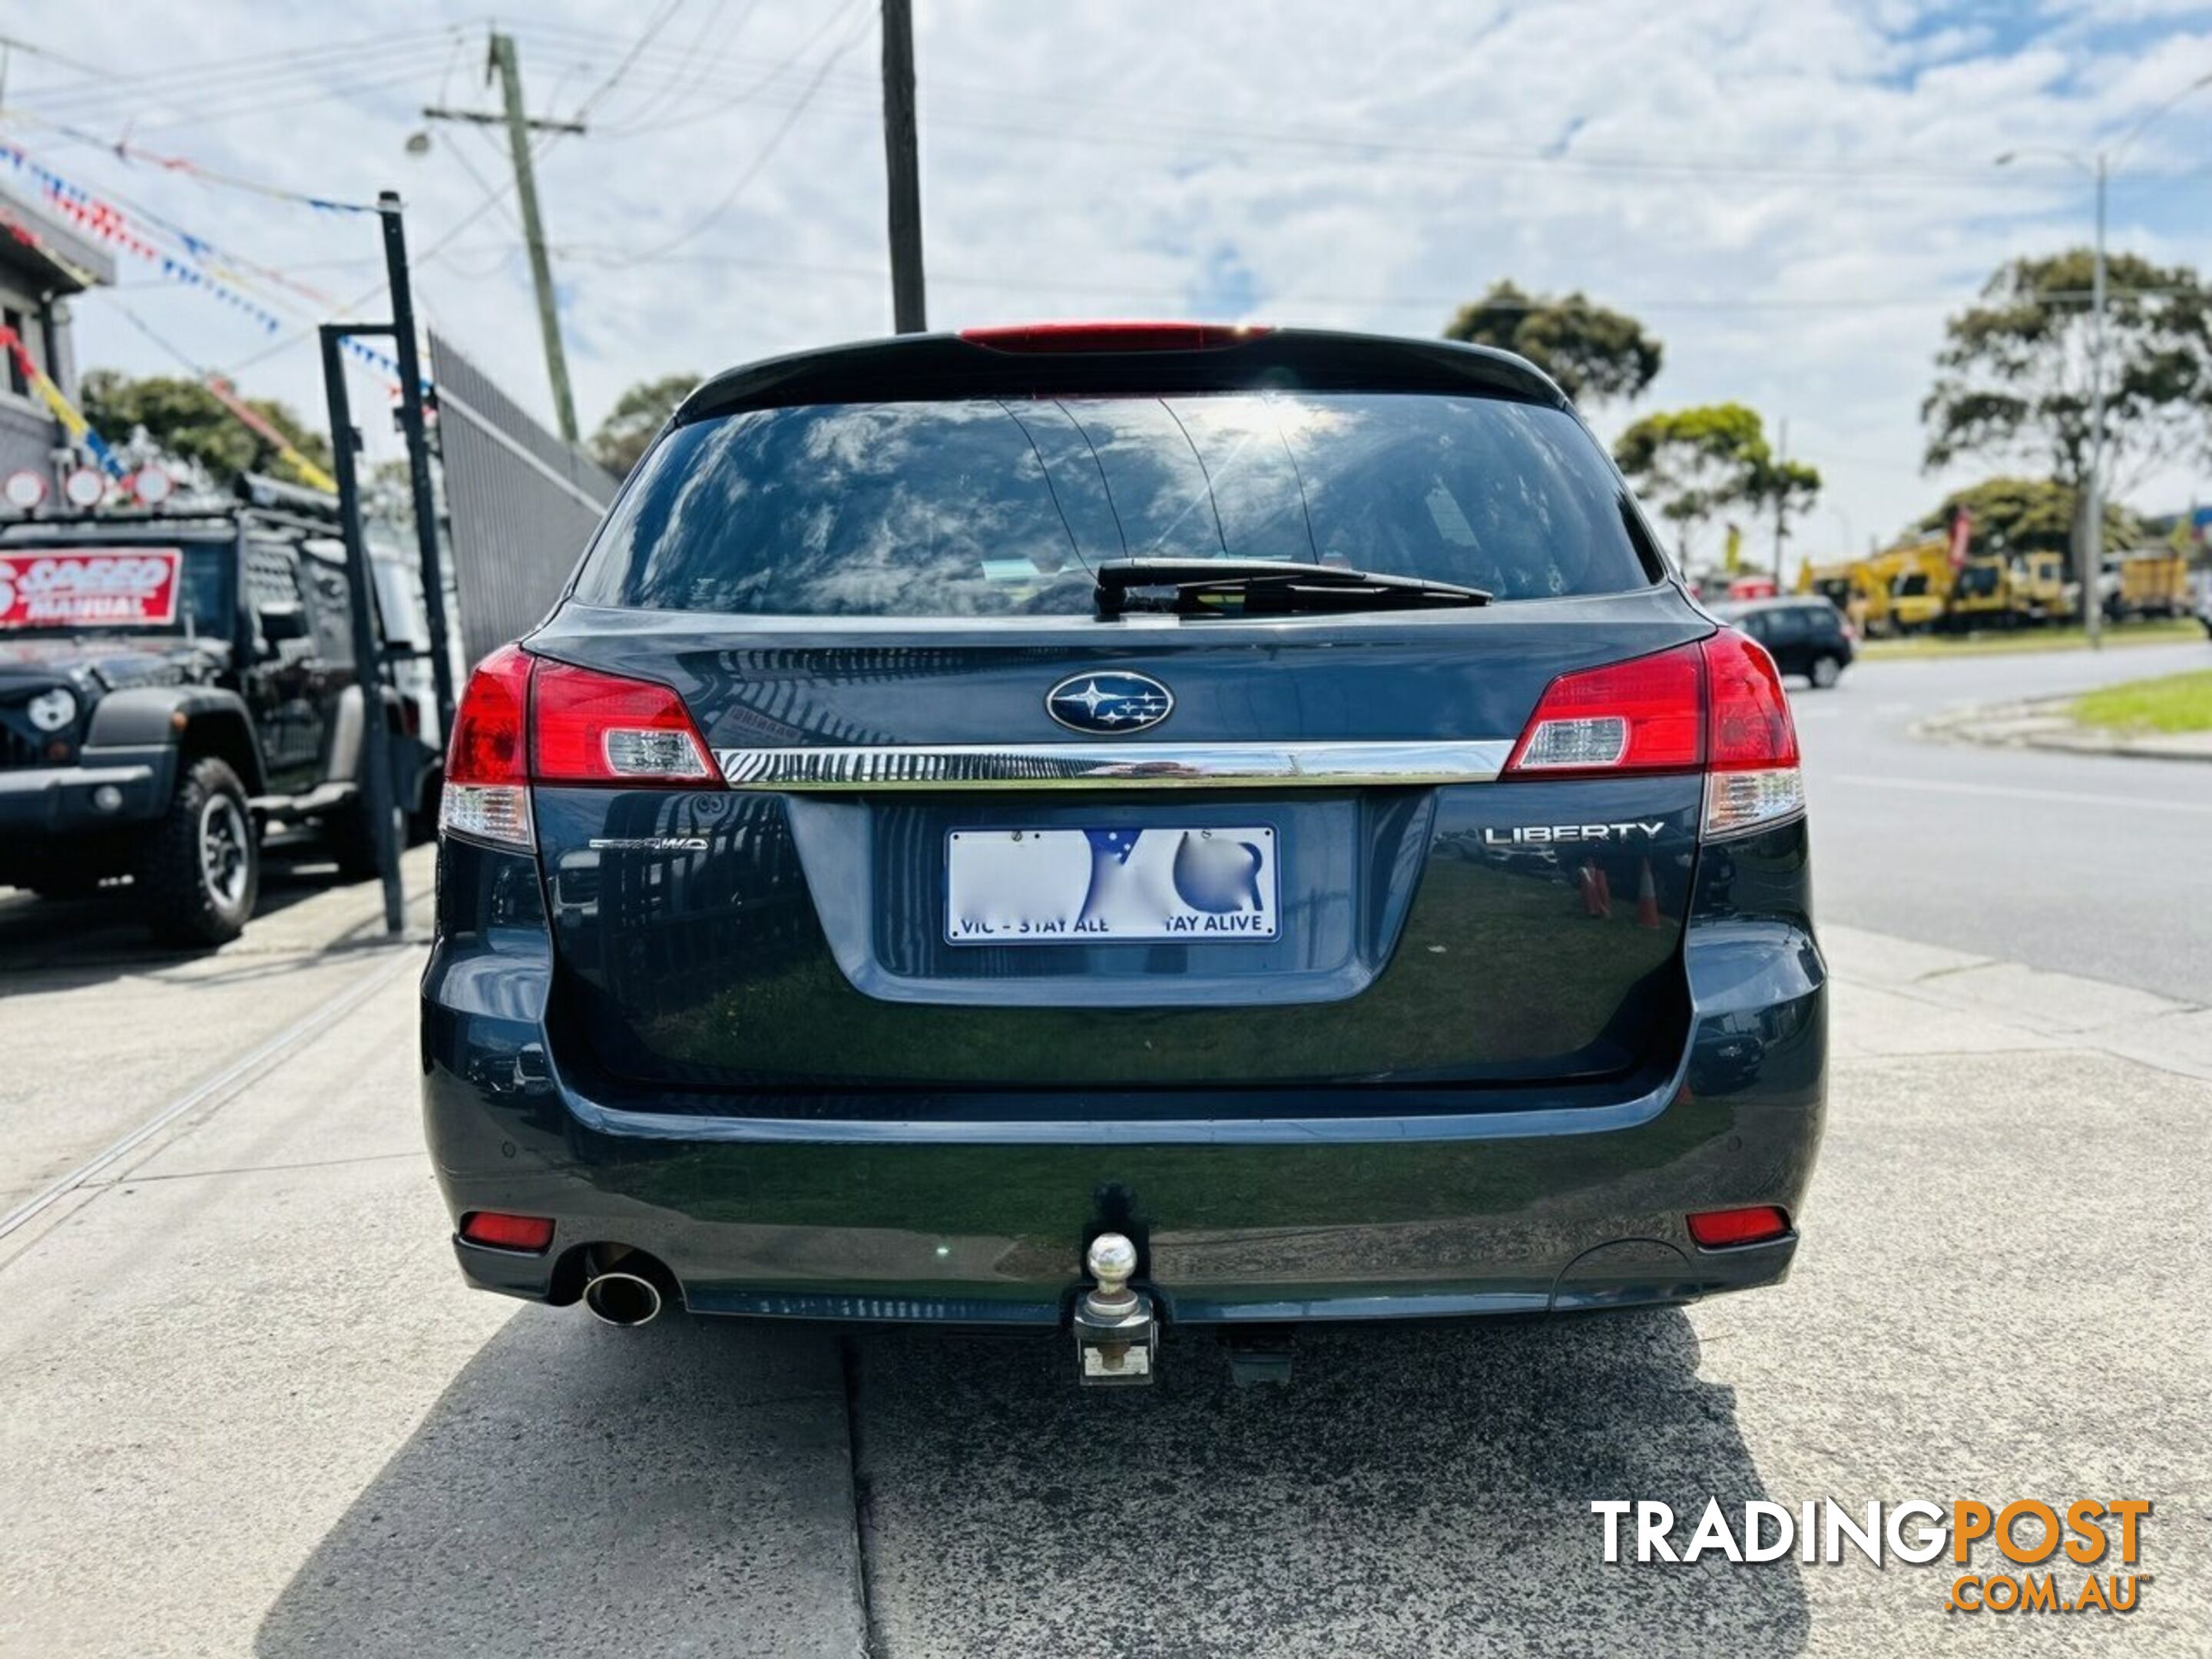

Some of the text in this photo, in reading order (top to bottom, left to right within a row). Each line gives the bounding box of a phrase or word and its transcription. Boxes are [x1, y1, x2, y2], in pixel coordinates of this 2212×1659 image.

[15, 558, 170, 590] SPEED
[28, 597, 144, 618] MANUAL
[1485, 821, 1665, 845] LIBERTY
[1165, 916, 1198, 932] TAY
[1204, 916, 1262, 931] ALIVE
